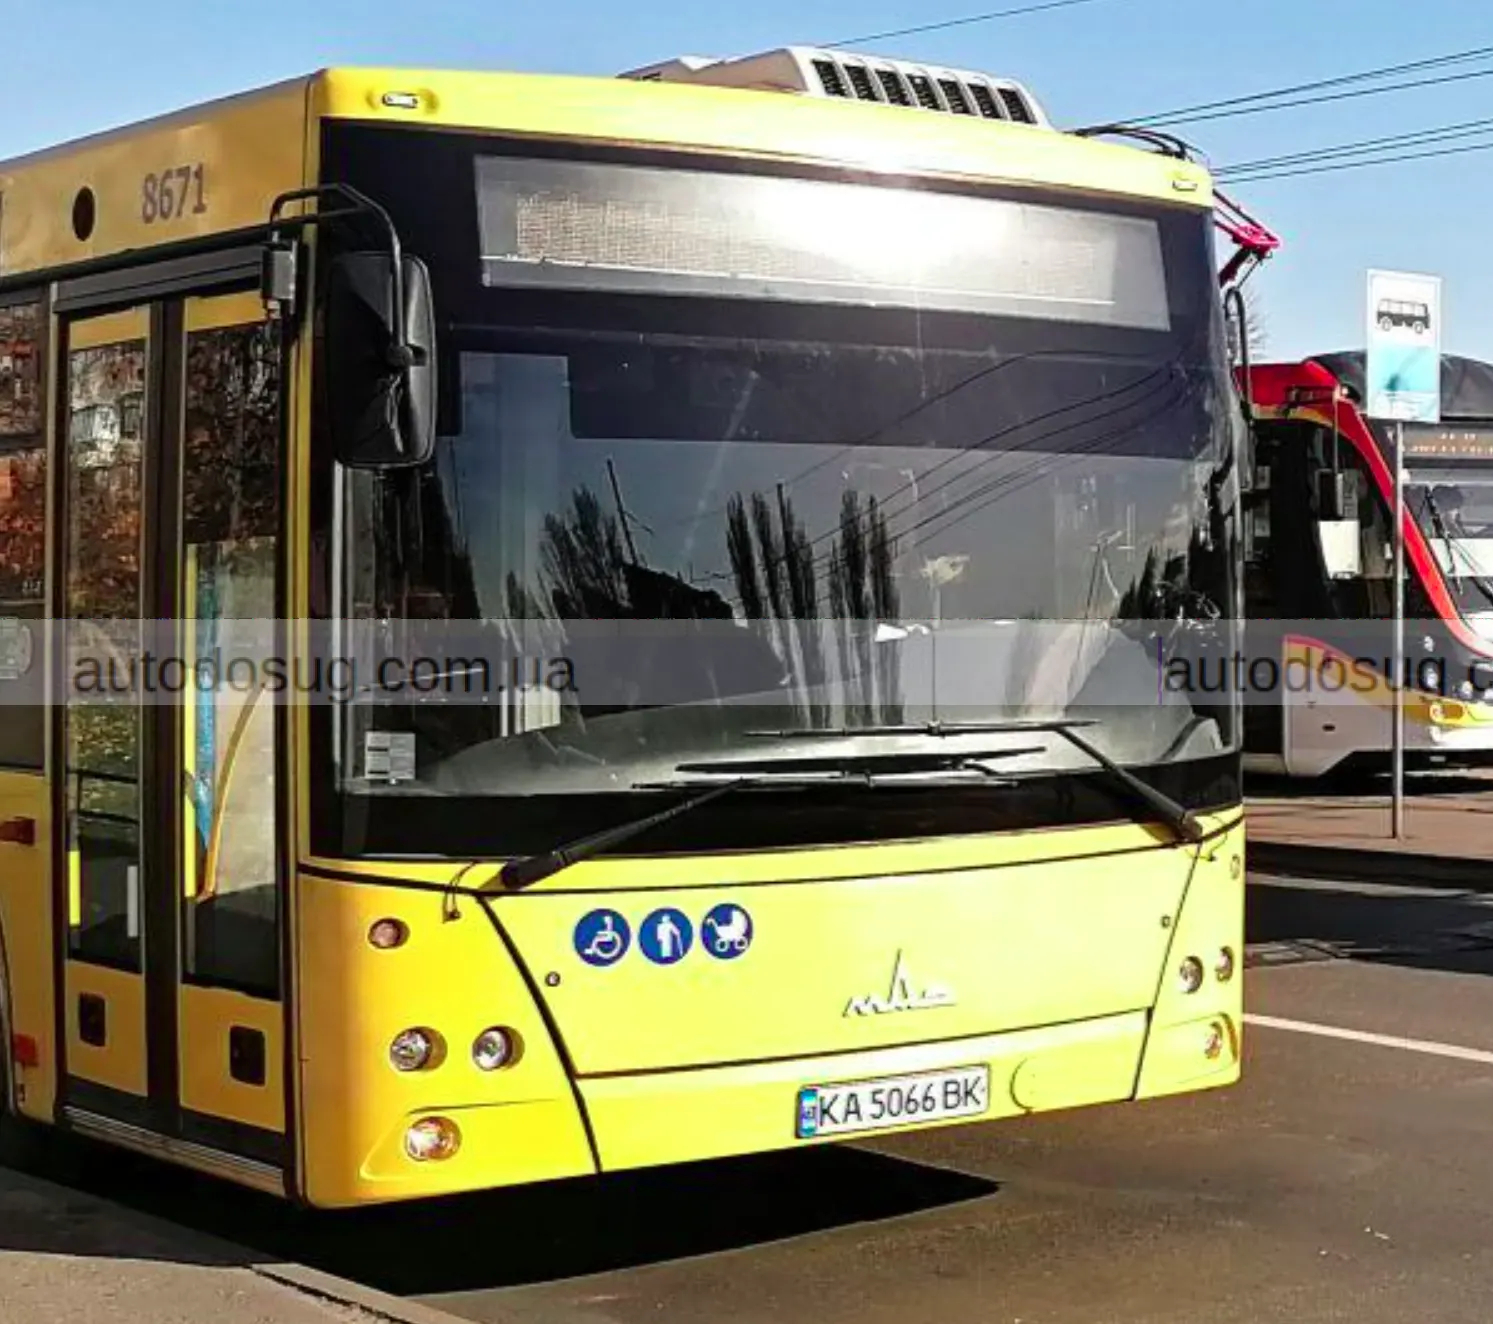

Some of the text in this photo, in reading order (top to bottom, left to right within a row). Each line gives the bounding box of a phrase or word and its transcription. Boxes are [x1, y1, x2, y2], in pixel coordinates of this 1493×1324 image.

[142, 162, 207, 225] 8671
[819, 1092, 863, 1126] KA
[870, 1083, 936, 1119] 5066
[943, 1076, 982, 1110] BK
